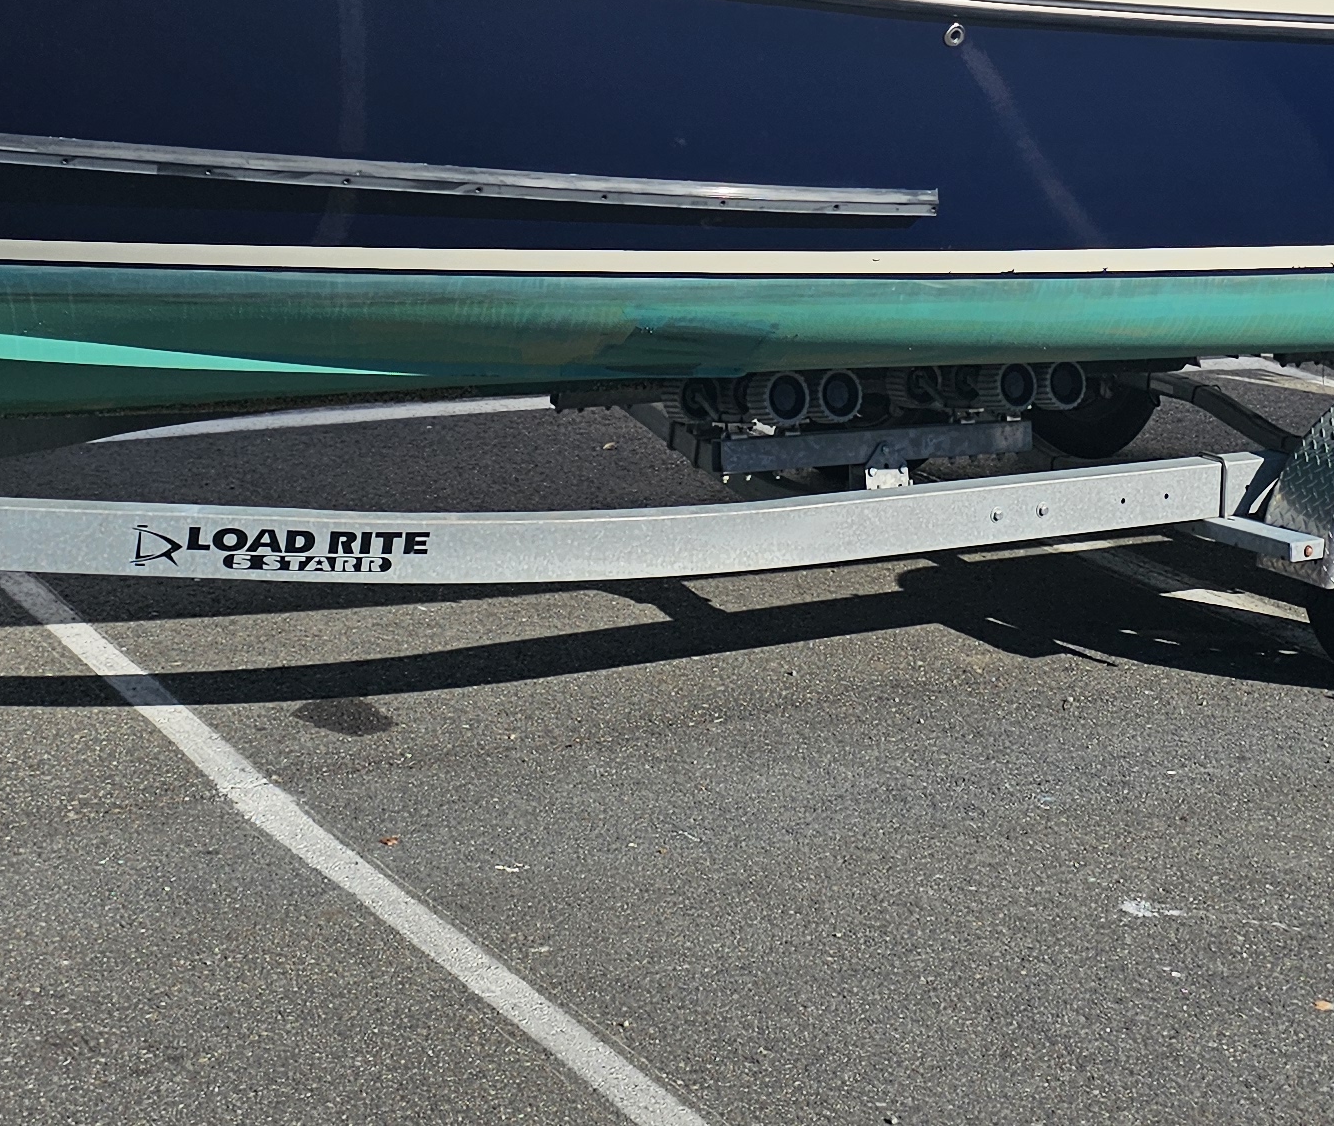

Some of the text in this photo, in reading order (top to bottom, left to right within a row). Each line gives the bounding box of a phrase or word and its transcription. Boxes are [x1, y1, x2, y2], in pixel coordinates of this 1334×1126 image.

[186, 525, 430, 555] LOAD RITE
[231, 556, 387, 573] 5 STARR
